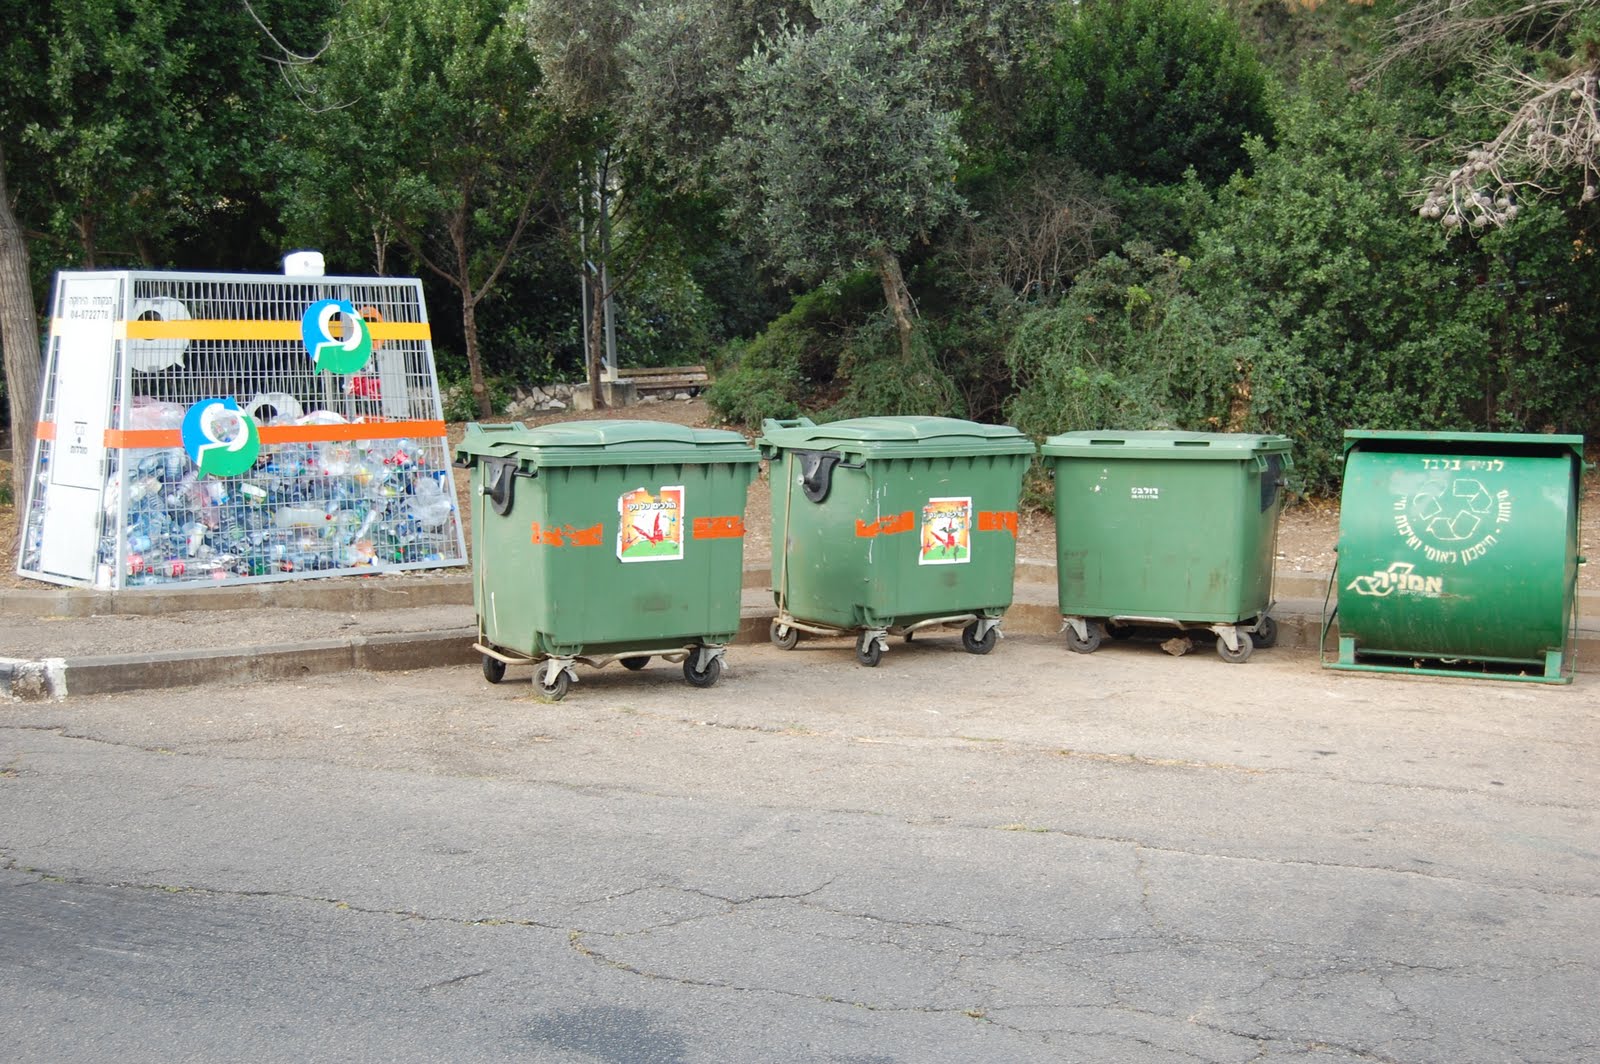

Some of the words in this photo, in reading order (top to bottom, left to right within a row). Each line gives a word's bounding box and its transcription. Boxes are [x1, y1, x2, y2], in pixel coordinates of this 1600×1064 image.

[1422, 459, 1460, 471] בלבד
[641, 502, 651, 511] על
[652, 501, 677, 510] הולכים
[1394, 514, 1423, 551] ואיכות
[1424, 545, 1457, 564] לאומי
[1461, 534, 1498, 566] חיסכון
[1373, 571, 1443, 593] אמניר
